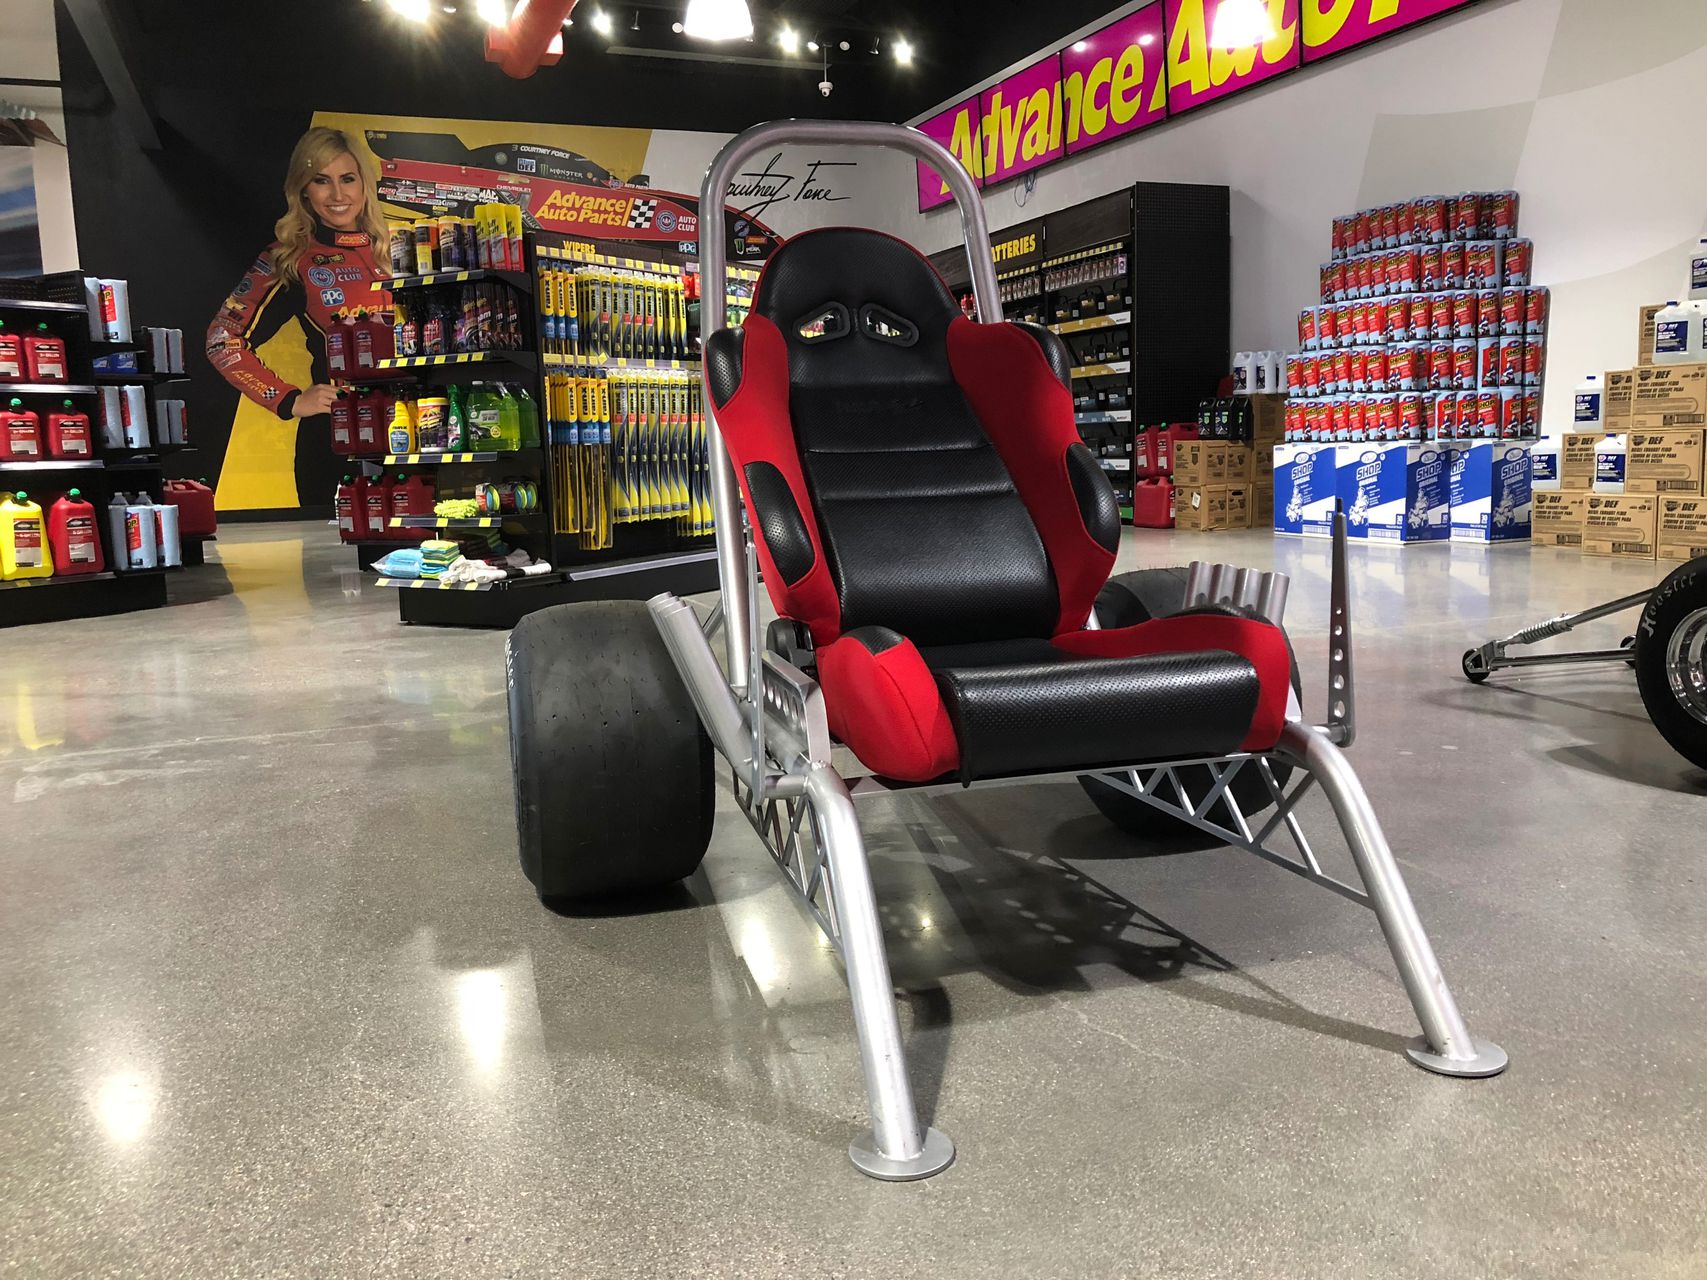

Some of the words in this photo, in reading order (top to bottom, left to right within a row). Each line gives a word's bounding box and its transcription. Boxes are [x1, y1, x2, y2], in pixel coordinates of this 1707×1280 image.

[939, 43, 1144, 196] Advance
[520, 145, 550, 156] COURTNEY
[550, 149, 571, 160] FORCE
[549, 168, 584, 179] MONSTER
[496, 184, 532, 193] CHEVROLET
[543, 189, 627, 212] Advance
[535, 205, 578, 222] Auto
[578, 208, 623, 226] Parts
[678, 216, 697, 224] AUTO
[677, 223, 696, 232] CLUB
[563, 240, 596, 254] WIPERS
[991, 233, 1036, 263] ATTERIES
[335, 266, 360, 274] AUTO
[338, 273, 363, 282] CLUB
[322, 290, 344, 304] PPG
[1655, 370, 1671, 379] DEF
[1580, 437, 1595, 445] DEF
[1648, 436, 1664, 445] DEF
[1292, 462, 1313, 479] SHOP
[1357, 462, 1382, 480] SHOP
[1417, 461, 1442, 480] SHOP
[1451, 459, 1464, 474] OP
[1501, 458, 1528, 480] SHOP
[1549, 495, 1562, 503] DEF
[1604, 500, 1619, 508] DEF
[1682, 502, 1698, 511] DEF
[1641, 571, 1698, 638] Hoosier
